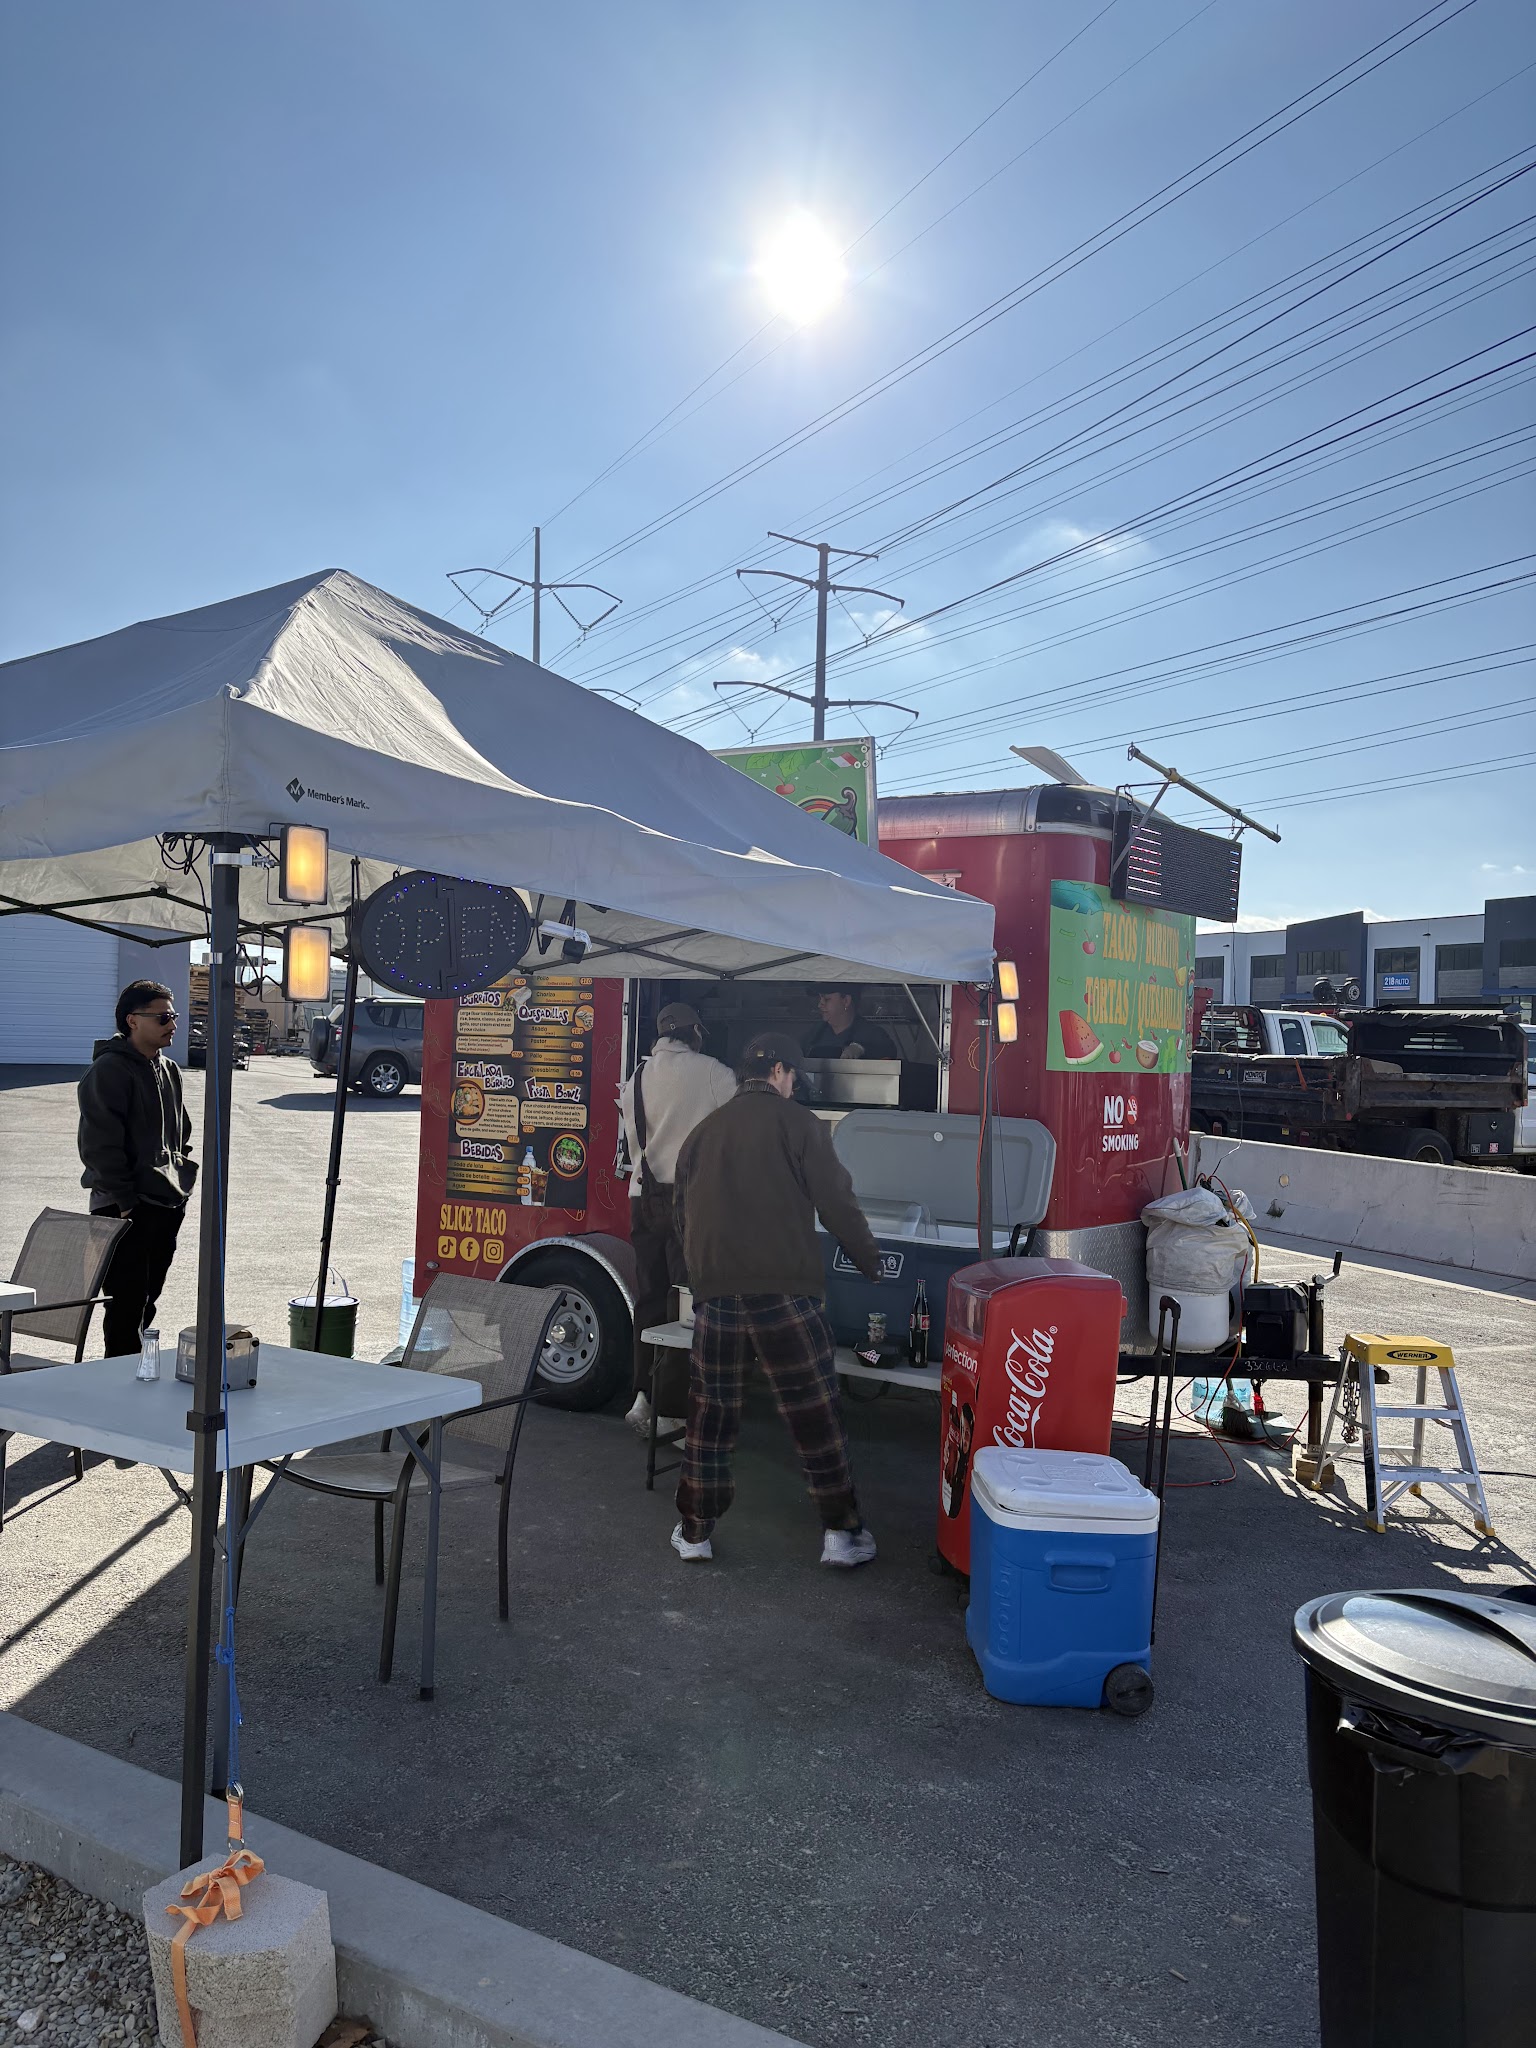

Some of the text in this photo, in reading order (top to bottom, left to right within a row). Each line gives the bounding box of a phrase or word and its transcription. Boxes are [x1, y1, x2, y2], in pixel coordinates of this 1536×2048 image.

[307, 788, 344, 805] Member's
[376, 904, 517, 964] OPEN
[1103, 912, 1137, 963] TACOS
[1384, 977, 1395, 986] 218
[460, 991, 501, 1006] BURRITOS
[1086, 976, 1129, 1026] TORTAS
[518, 1005, 569, 1025] QUESADILLAS
[484, 1077, 514, 1089] BURRITO
[525, 1077, 581, 1102] FIESTA BOWL
[1104, 1095, 1124, 1124] NO
[461, 1139, 504, 1162] BEBIDAS
[1102, 1133, 1139, 1152] SMOKING
[440, 1203, 507, 1236] SLICE TACO
[945, 1341, 978, 1374] perfection
[993, 1327, 1055, 1448] oca-Cola
